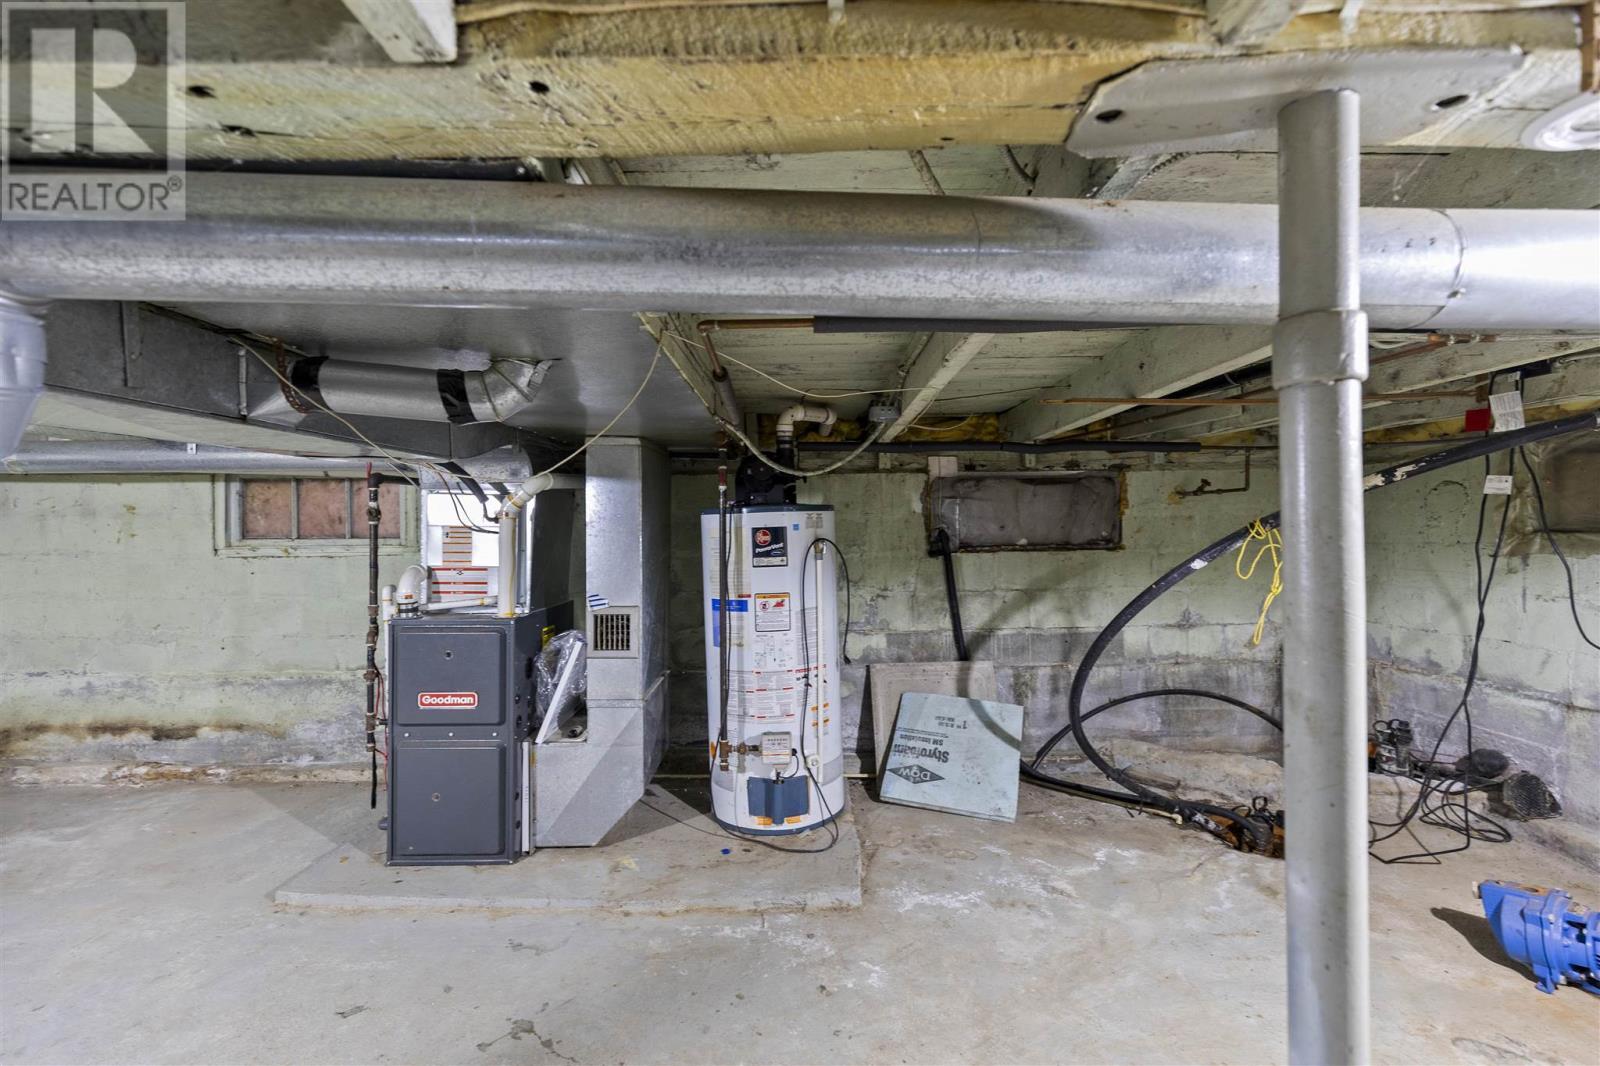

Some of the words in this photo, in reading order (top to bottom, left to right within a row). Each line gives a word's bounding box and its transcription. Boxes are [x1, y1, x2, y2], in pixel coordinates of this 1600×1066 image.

[421, 695, 474, 704] Goodman
[893, 743, 950, 763] Styrofoam
[899, 766, 931, 780] DOW
